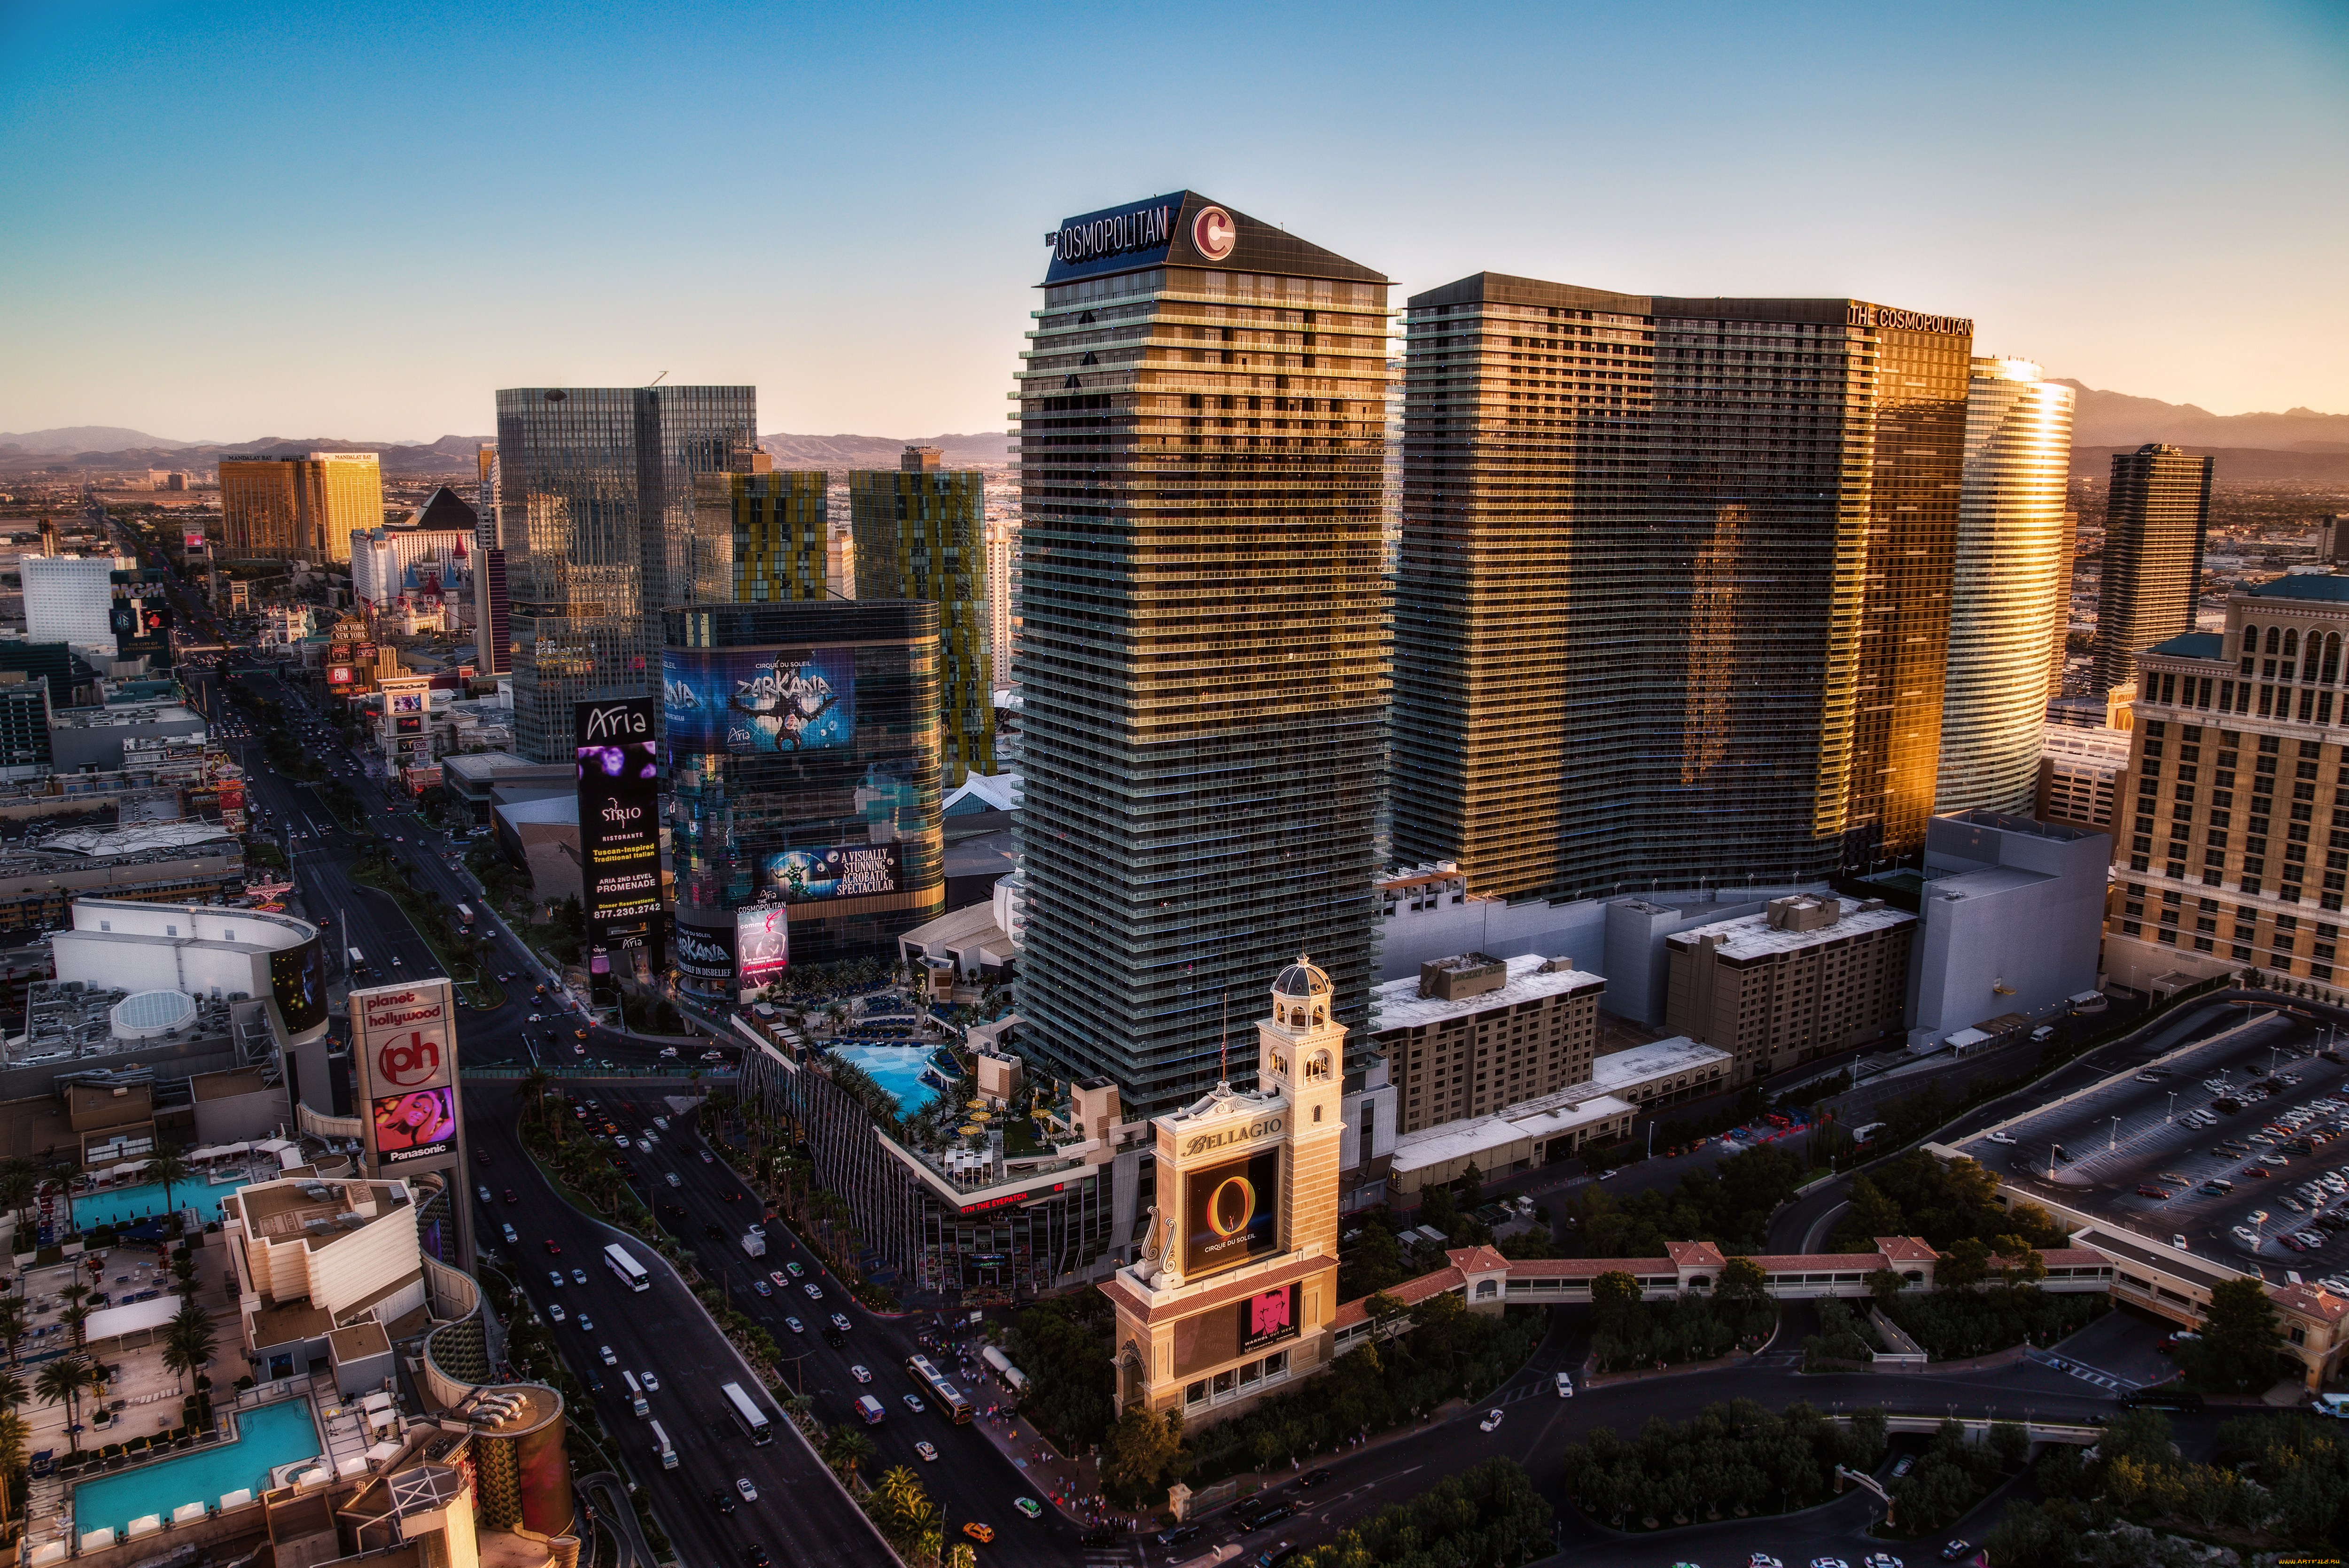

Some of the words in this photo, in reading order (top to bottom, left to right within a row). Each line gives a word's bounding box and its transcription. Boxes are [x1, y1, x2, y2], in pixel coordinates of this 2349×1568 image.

[1045, 232, 1057, 248] THE
[1056, 205, 1168, 261] COSMOPOLITAN
[1850, 305, 1876, 326] THE
[1880, 309, 1974, 336] COSMOPOLITAN
[111, 582, 166, 599] MGM
[334, 670, 348, 679] FUN
[735, 670, 833, 702] ZARKANA
[587, 705, 646, 740] Aria
[727, 727, 750, 743] Aria
[602, 807, 641, 822] SIRIO
[603, 832, 644, 842] RISTORANTE
[593, 843, 655, 856] Tuscan-Inspired
[841, 852, 848, 863] A
[848, 848, 888, 862] VISUALLY
[594, 854, 632, 863] Traditional
[844, 859, 886, 874] STUNNING
[842, 869, 889, 885] ACROBATIC
[597, 878, 656, 893] PROMENADE
[837, 879, 894, 896] SPECTACULAR
[619, 897, 656, 907] Reservations:
[760, 889, 777, 900] Aria
[594, 903, 661, 919] 877.230.2742
[738, 901, 786, 914] COSMOPOLITAN
[740, 921, 766, 930] comme
[622, 937, 643, 950] Aria
[677, 935, 731, 962] ARKANA
[696, 967, 701, 975] IN
[702, 968, 731, 977] DISBELIEF
[367, 992, 415, 1012] planet
[369, 1005, 441, 1027] hollywood
[383, 1032, 439, 1084] ph
[1181, 1118, 1282, 1157] BELLAGIO
[390, 1144, 446, 1161] Panasonic
[1054, 1183, 1064, 1192] GE
[976, 1201, 991, 1211] THE
[992, 1193, 1028, 1207] EYEPATCH.
[1205, 1242, 1226, 1253] CIRQUE
[1237, 1234, 1257, 1245] SOLEIL
[1245, 1335, 1268, 1346] WARHOL
